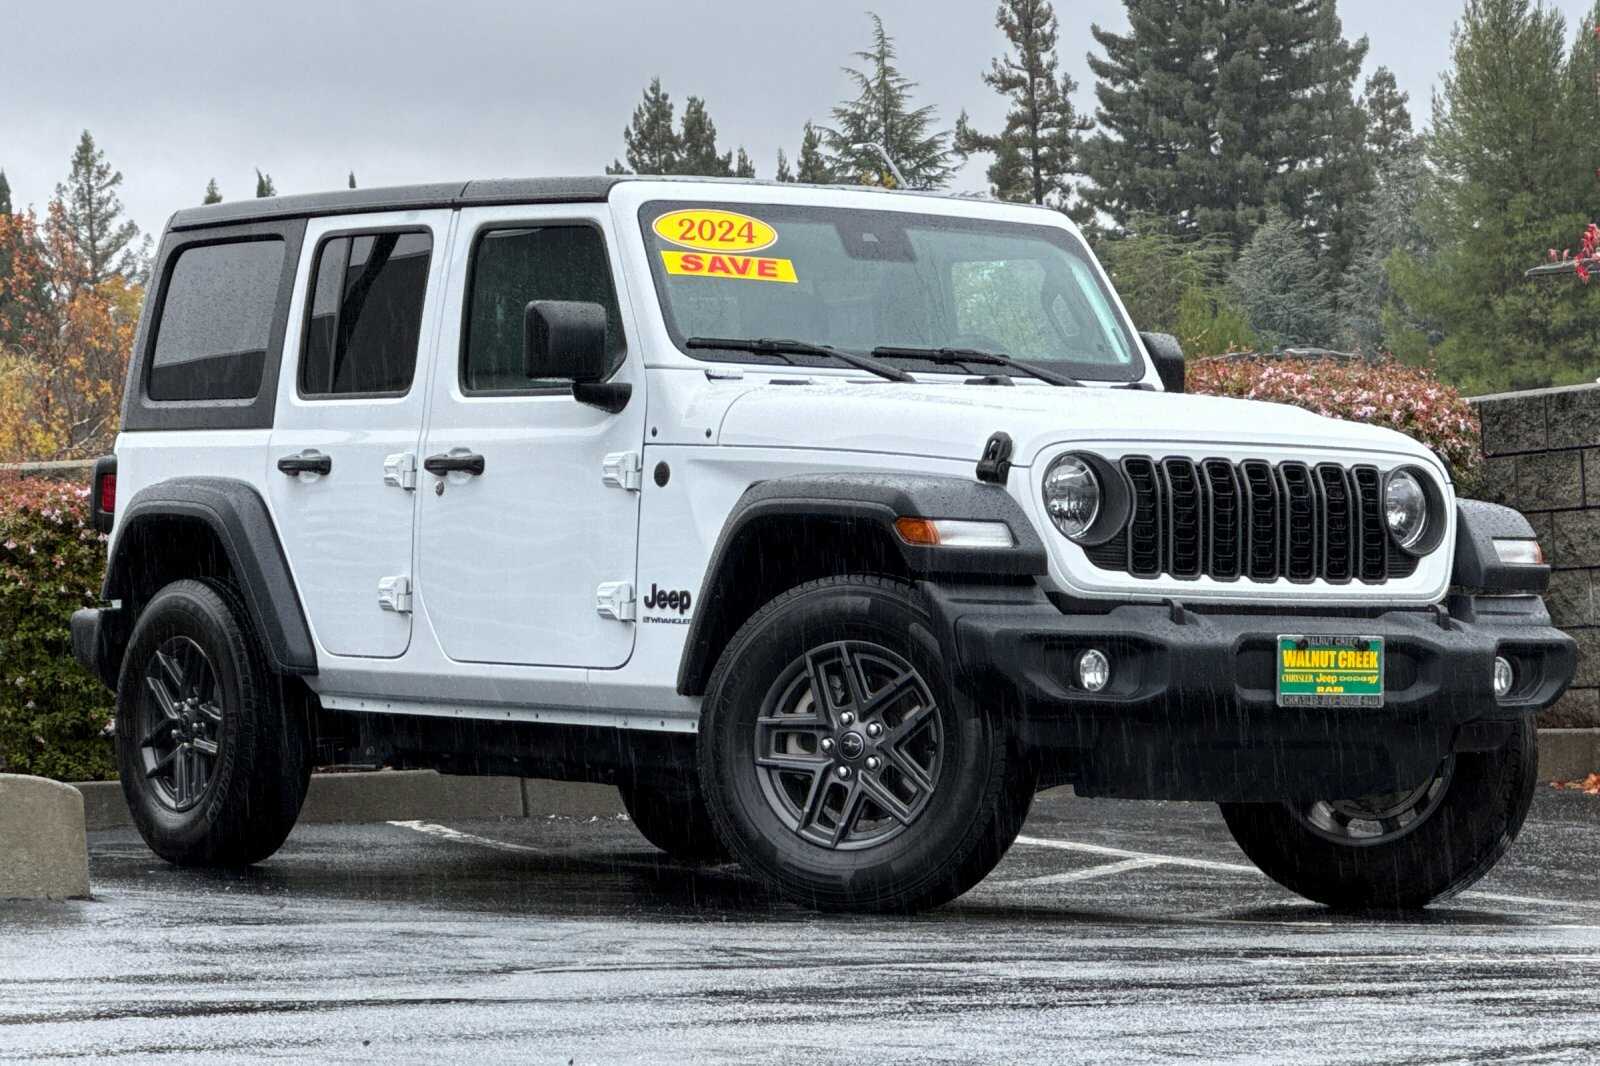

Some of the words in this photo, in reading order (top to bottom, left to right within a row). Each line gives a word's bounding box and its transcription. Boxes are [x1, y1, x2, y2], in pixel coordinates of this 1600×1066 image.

[678, 218, 757, 244] 2024
[680, 254, 778, 278] SAVE
[643, 583, 691, 615] Jeep
[1283, 650, 1336, 668] WALNUT
[1338, 650, 1379, 668] CREEK
[1282, 673, 1313, 683] CHRYSLER
[1316, 673, 1338, 684] Jeep
